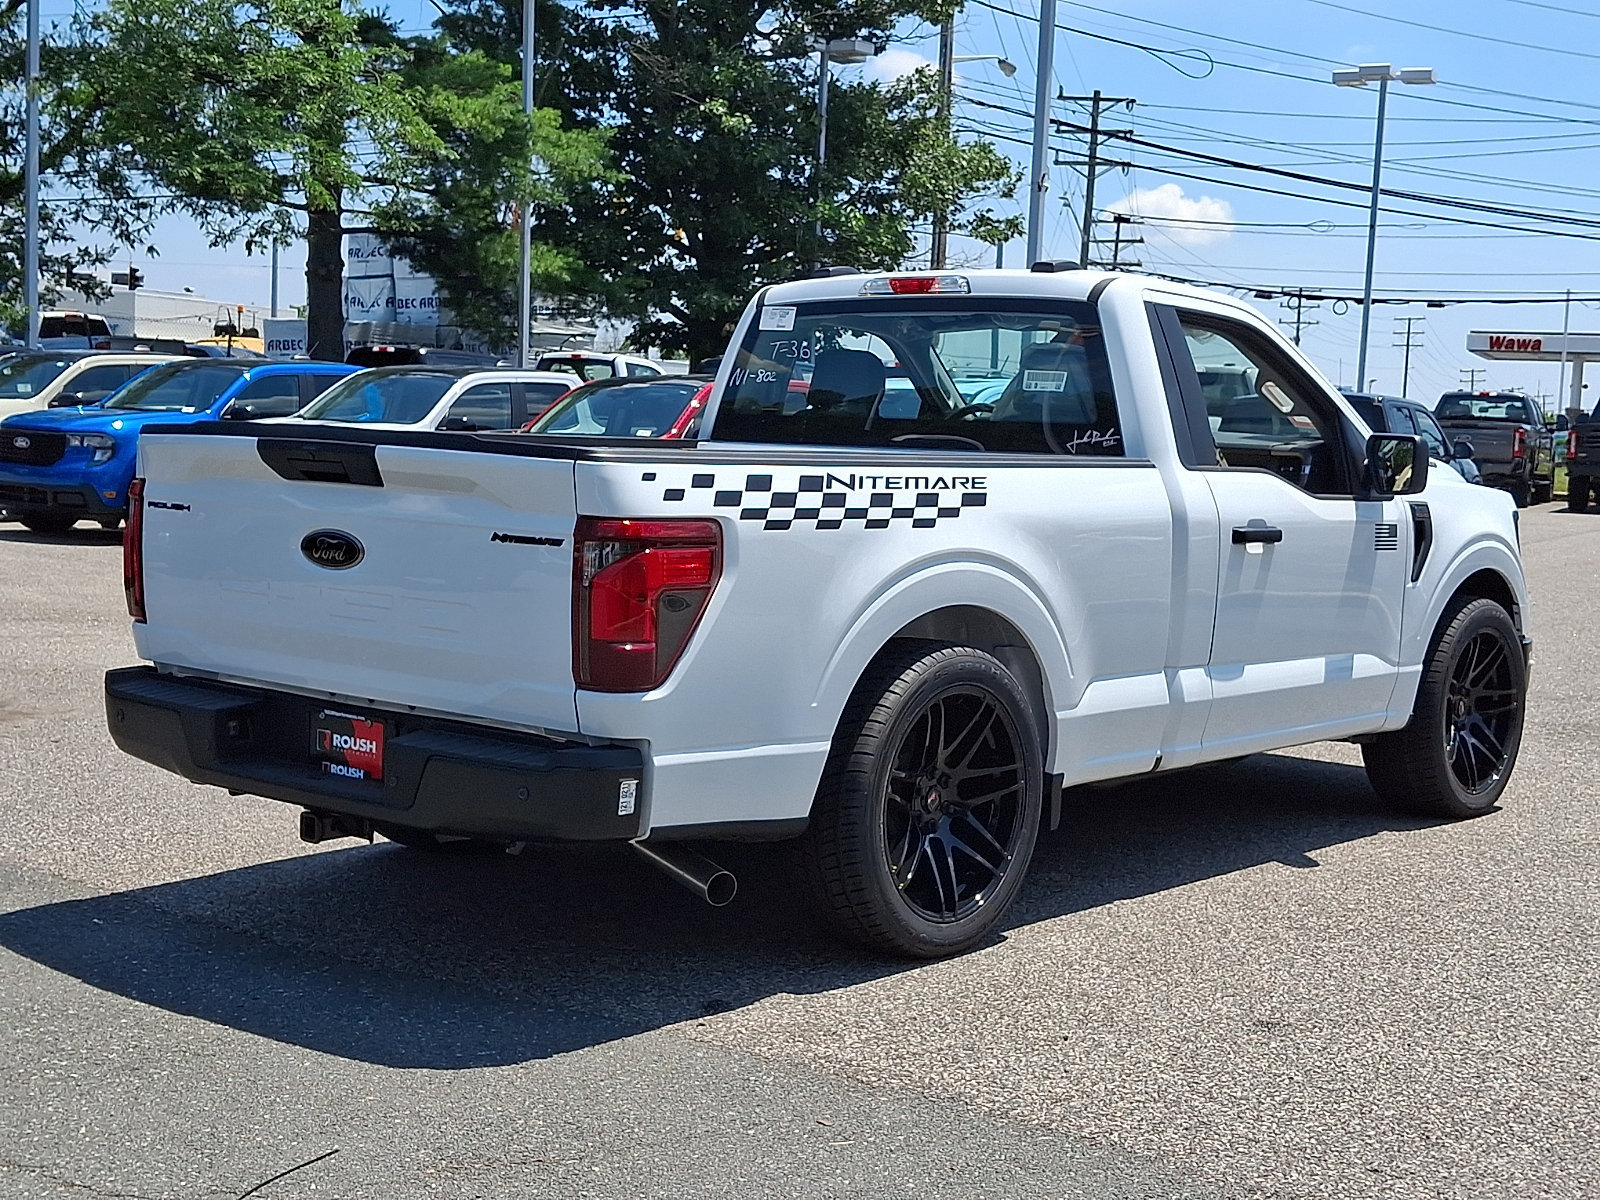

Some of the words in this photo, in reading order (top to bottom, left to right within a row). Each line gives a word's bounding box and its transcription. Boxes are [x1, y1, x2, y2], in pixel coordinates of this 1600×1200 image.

[267, 339, 303, 351] ARBEC
[1489, 336, 1542, 350] Wawa
[826, 472, 988, 491] NITEMARE
[312, 537, 347, 561] Ford
[333, 733, 377, 754] ROUSH
[330, 763, 364, 780] ROUSH
